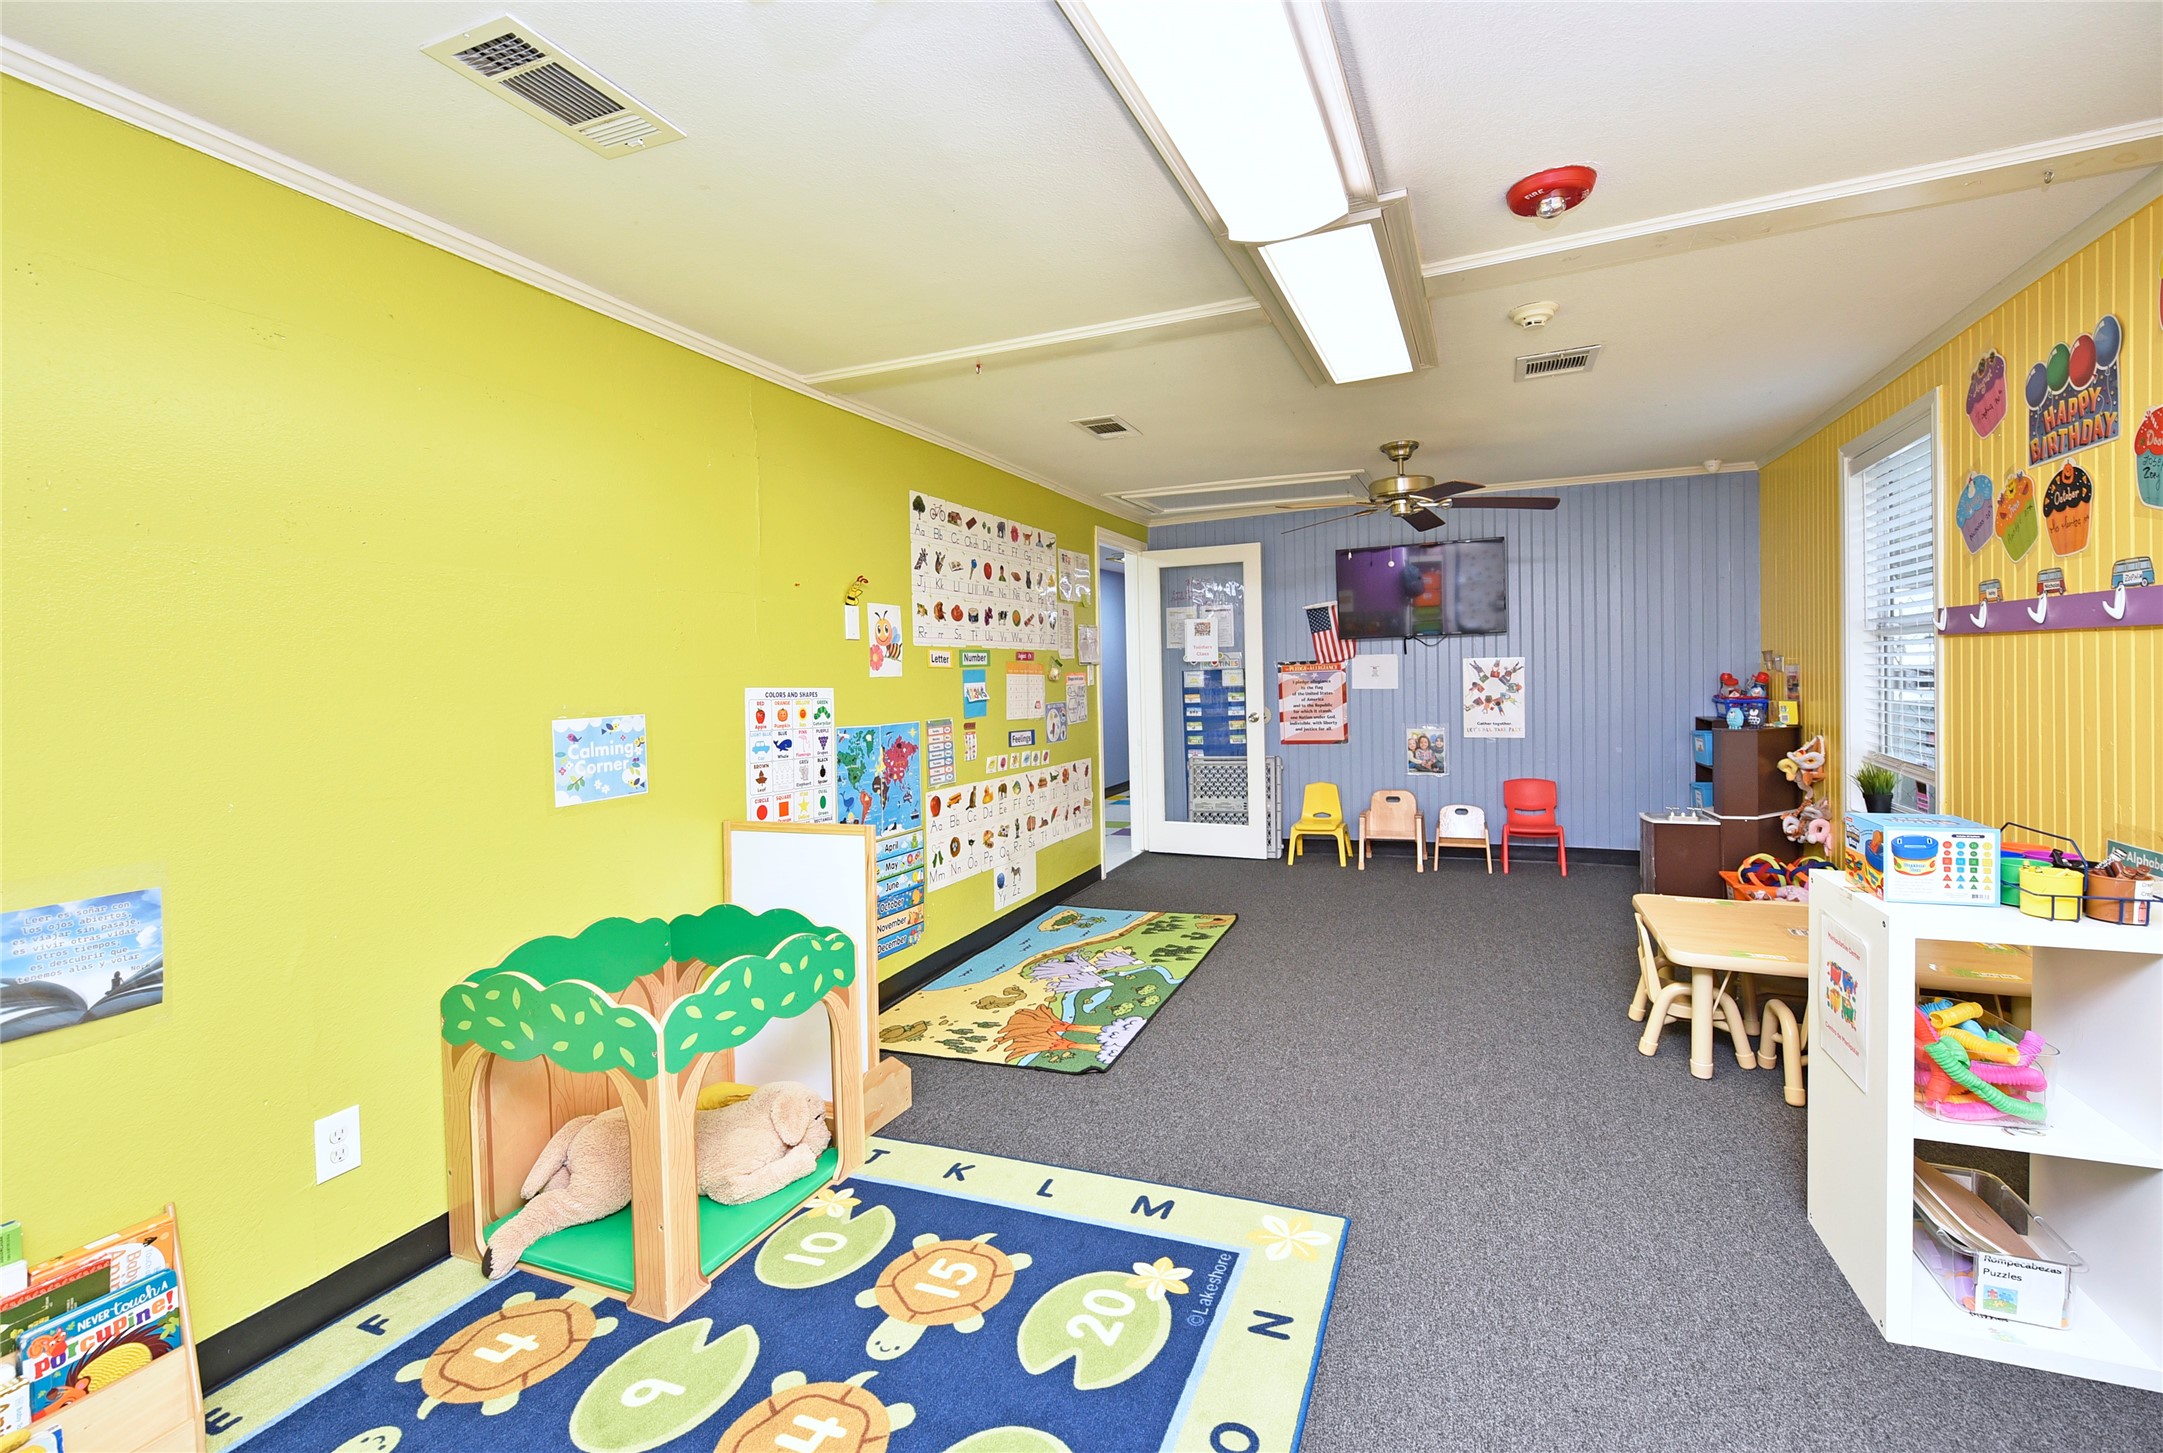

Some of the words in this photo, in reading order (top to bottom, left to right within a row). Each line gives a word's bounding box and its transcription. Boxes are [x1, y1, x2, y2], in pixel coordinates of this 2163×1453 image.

[1524, 188, 1546, 200] FIRE
[2042, 386, 2103, 431] HAPPY
[2029, 410, 2119, 466] BIRTHDAY
[2053, 486, 2080, 506] October
[914, 523, 926, 536] Aa
[933, 527, 943, 541] Bb
[982, 540, 992, 552] Dd
[916, 574, 927, 593] Jj
[935, 577, 945, 590] Kk
[918, 625, 928, 638] Rr
[954, 628, 962, 640] Ss
[930, 653, 950, 665] Letter
[963, 652, 987, 664] Number
[567, 740, 634, 760] Calming
[1012, 733, 1031, 744] Feelings
[574, 759, 630, 775] Corner
[930, 820, 943, 834] Aa
[949, 814, 960, 829] Bb
[966, 809, 977, 823] Cc
[982, 805, 994, 820] Dd
[999, 802, 1008, 816] Ee
[1013, 798, 1022, 812] Ff
[1025, 795, 1036, 811] Gg
[884, 840, 899, 853] April
[885, 860, 899, 872] May
[928, 869, 946, 885] Mm
[950, 862, 962, 877] Nn
[967, 856, 978, 870] Oo
[983, 851, 994, 867] Pp
[1013, 841, 1023, 853] Rr
[1027, 837, 1036, 849] Ss
[885, 881, 900, 892] June
[1012, 885, 1021, 897] Zz
[24, 914, 51, 926] Leer
[57, 911, 70, 920] es
[76, 904, 107, 916] soñar
[112, 901, 130, 910] con
[880, 897, 905, 913] October
[12, 938, 26, 947] es
[33, 929, 71, 944] viajar
[77, 925, 95, 935] sin
[101, 917, 141, 933] pasaje,
[22, 925, 42, 935] los
[48, 920, 74, 931] ojos
[79, 911, 132, 925] abiertos,
[876, 916, 907, 934] November
[12, 947, 26, 956] es
[33, 940, 65, 953] vivir
[71, 934, 101, 945] otras
[36, 949, 68, 962] otros
[74, 939, 121, 953] tiempos,
[877, 935, 907, 954] December
[17, 968, 63, 985] tenemos
[68, 962, 94, 974] alas
[99, 961, 105, 969] y
[111, 953, 140, 965] volar
[30, 963, 43, 972] es
[49, 951, 105, 968] descubrir
[110, 946, 129, 958] que
[864, 1148, 891, 1165] J
[943, 1162, 981, 1181] K
[1035, 1178, 1057, 1198] L
[1130, 1195, 1175, 1221] M
[782, 1230, 850, 1268] 10
[1982, 1267, 2023, 1283] Puzzles
[1983, 1254, 2063, 1275] Rompecabezas
[912, 1256, 981, 1299] 15
[77, 1309, 110, 1333] NEVER
[108, 1285, 161, 1316] touch
[161, 1280, 169, 1291] A
[1064, 1288, 1137, 1346] 20
[355, 1312, 390, 1336] F
[1247, 1310, 1295, 1341] N
[472, 1331, 540, 1364] 4
[620, 1377, 687, 1408] 9
[204, 1406, 243, 1435] E
[1210, 1421, 1260, 1453] O
